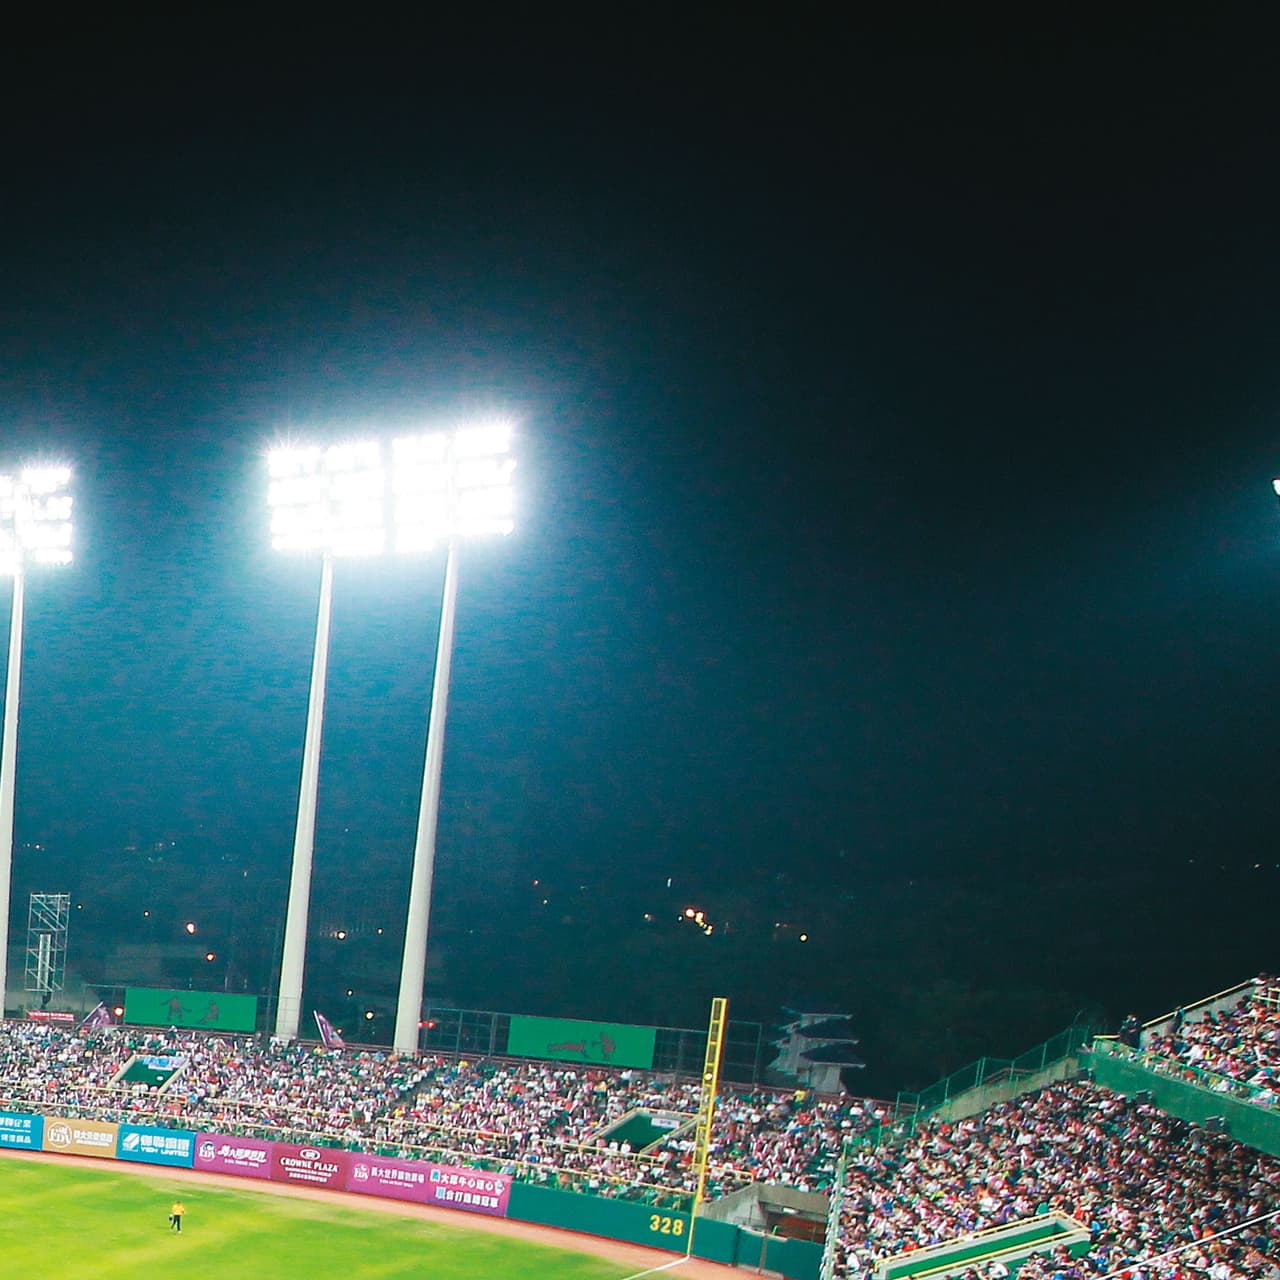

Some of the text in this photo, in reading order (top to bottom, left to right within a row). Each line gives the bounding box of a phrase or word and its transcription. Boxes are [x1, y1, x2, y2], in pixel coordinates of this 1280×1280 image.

[280, 1156, 312, 1169] CROWNE
[313, 1161, 338, 1173] PLAZA
[649, 1214, 684, 1236] 328
